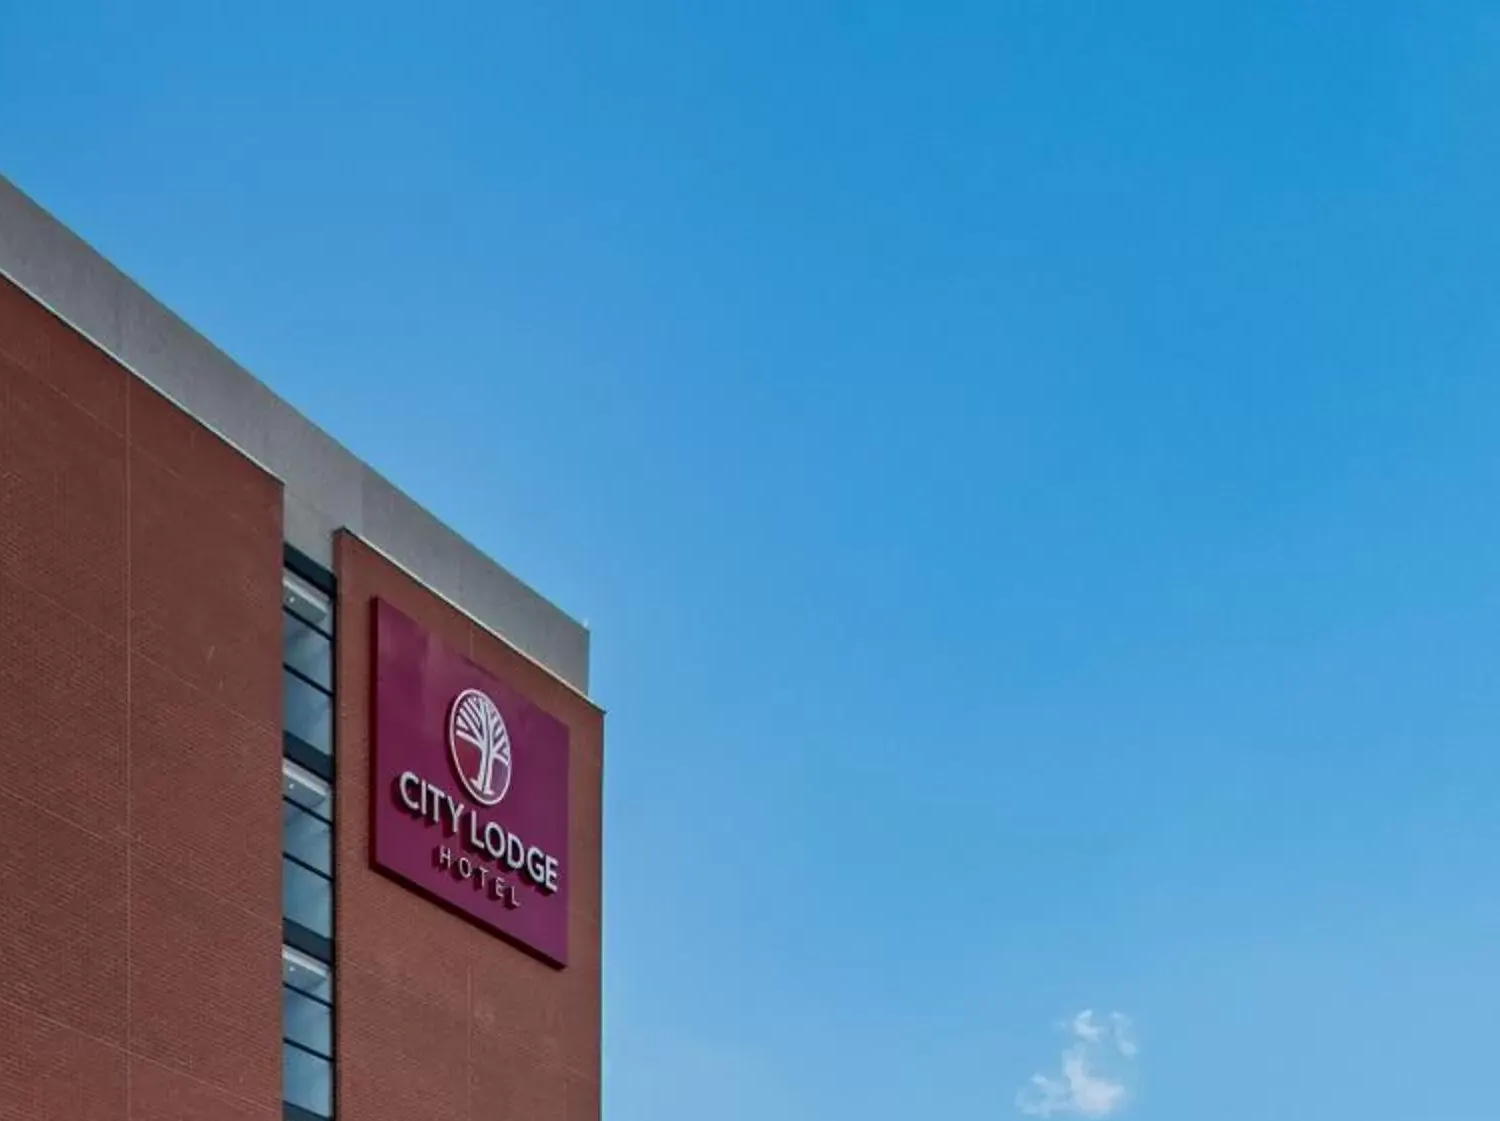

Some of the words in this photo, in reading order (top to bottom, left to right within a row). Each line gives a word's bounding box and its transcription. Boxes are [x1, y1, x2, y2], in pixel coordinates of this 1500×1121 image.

[399, 770, 464, 832] CITY
[471, 811, 559, 892] LODGE
[438, 846, 520, 907] HOTEL
